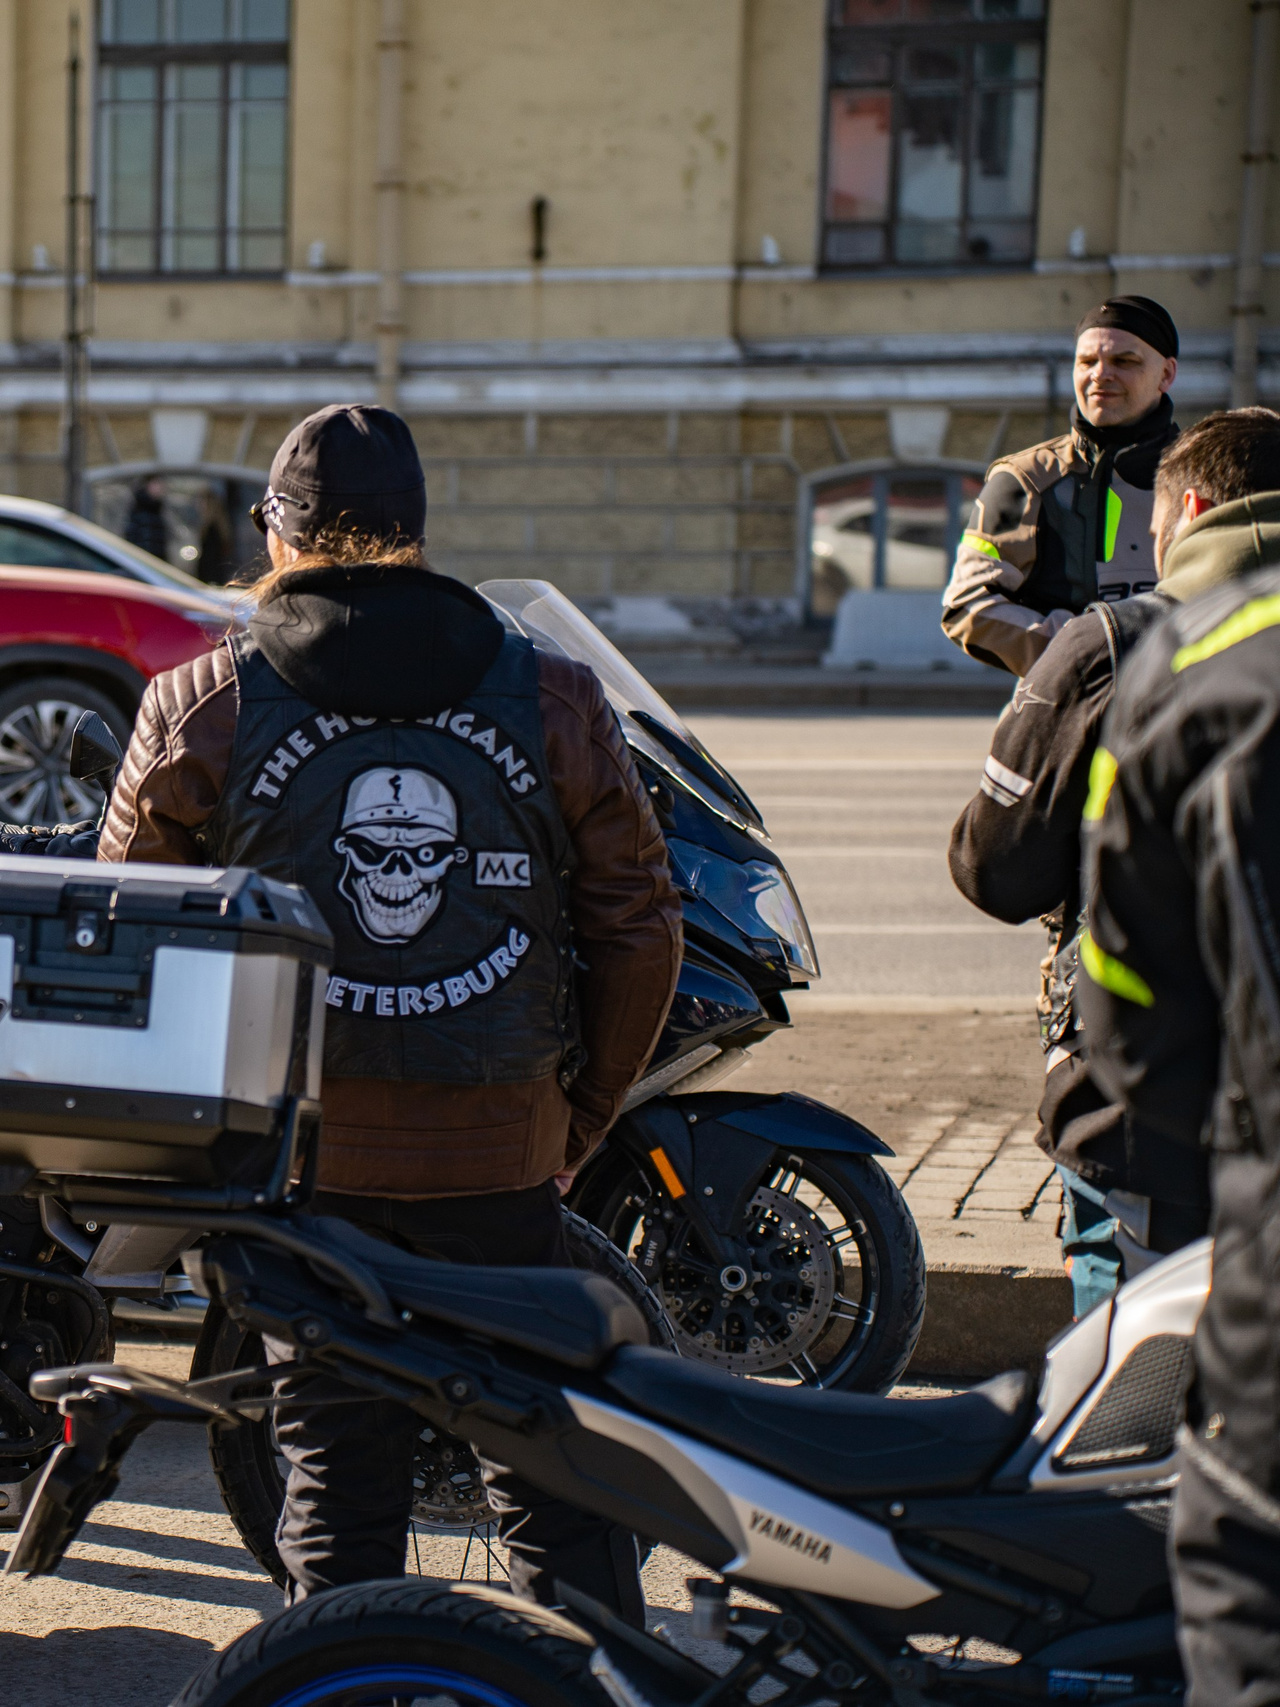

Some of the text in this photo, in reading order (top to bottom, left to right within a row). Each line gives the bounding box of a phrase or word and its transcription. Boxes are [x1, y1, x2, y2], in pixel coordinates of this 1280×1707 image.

[251, 708, 538, 799] THE HIGANS
[479, 858, 529, 882] MC
[324, 926, 531, 1017] ETERSBURG
[644, 1240, 658, 1267] BMW
[750, 1509, 834, 1565] YAMAHA
